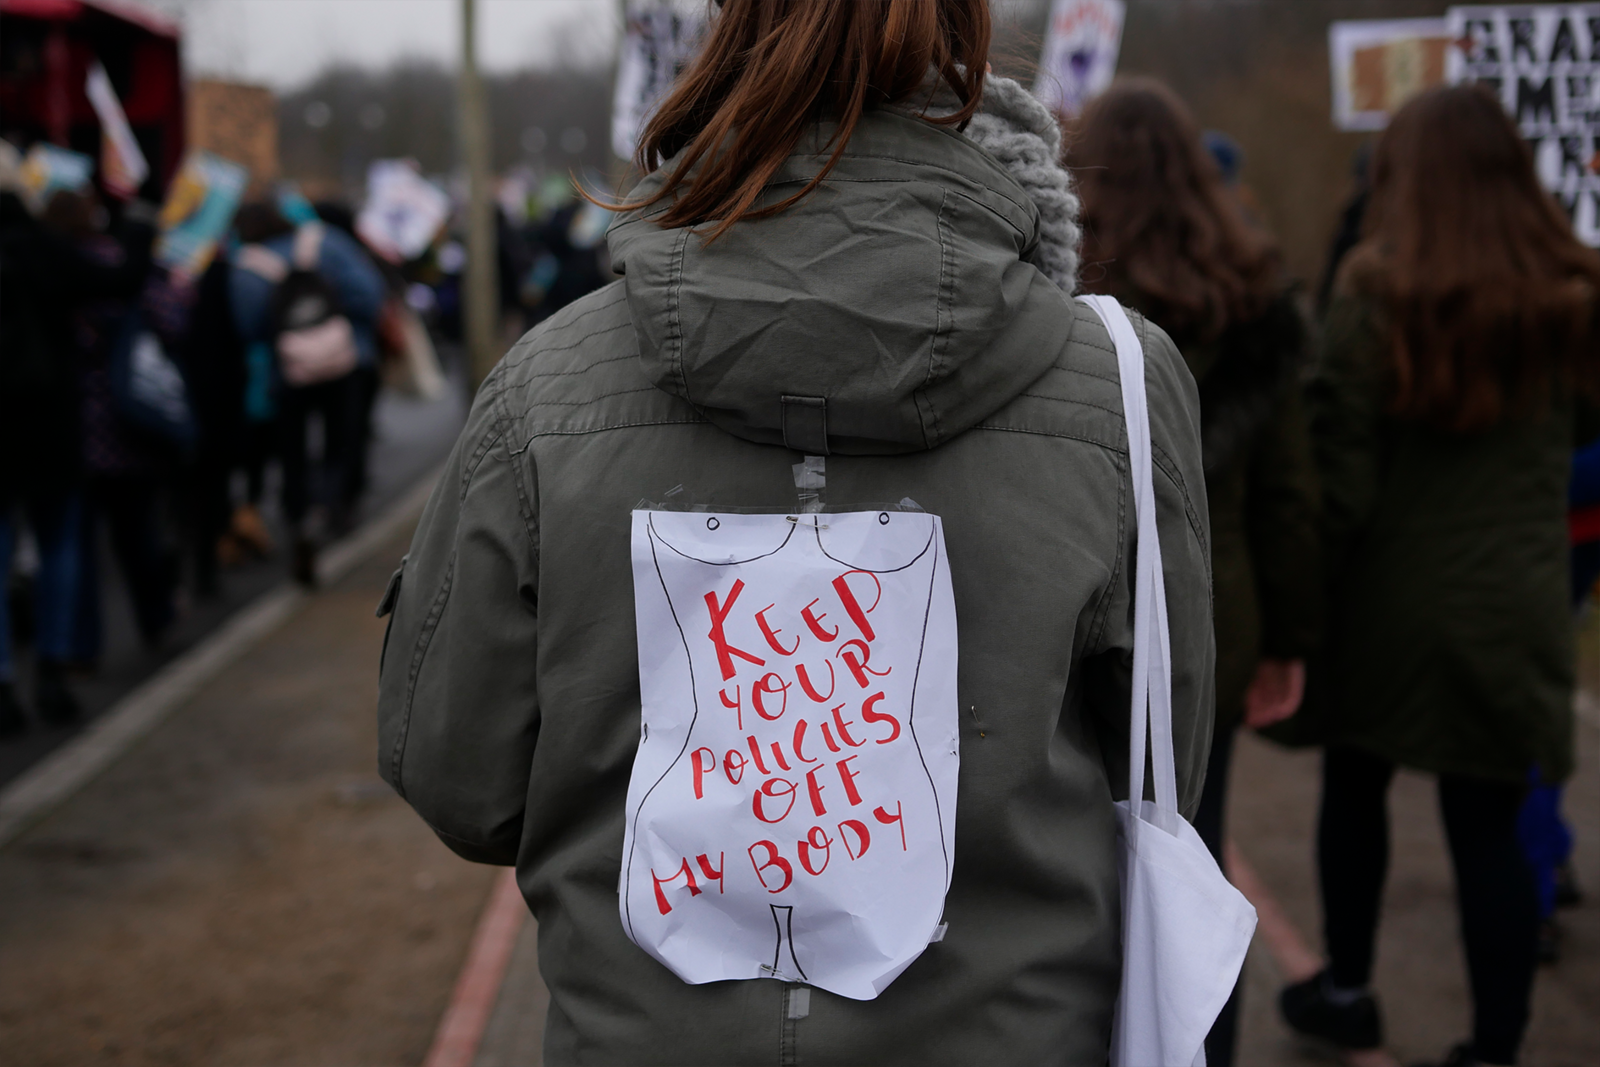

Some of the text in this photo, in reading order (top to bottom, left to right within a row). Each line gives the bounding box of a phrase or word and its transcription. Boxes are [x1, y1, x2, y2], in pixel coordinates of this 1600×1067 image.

[703, 569, 882, 682] KEEP
[718, 638, 892, 731] YOUR
[690, 691, 901, 800] POLICIES
[752, 754, 863, 824] OFF
[650, 800, 908, 916] MY BODY
